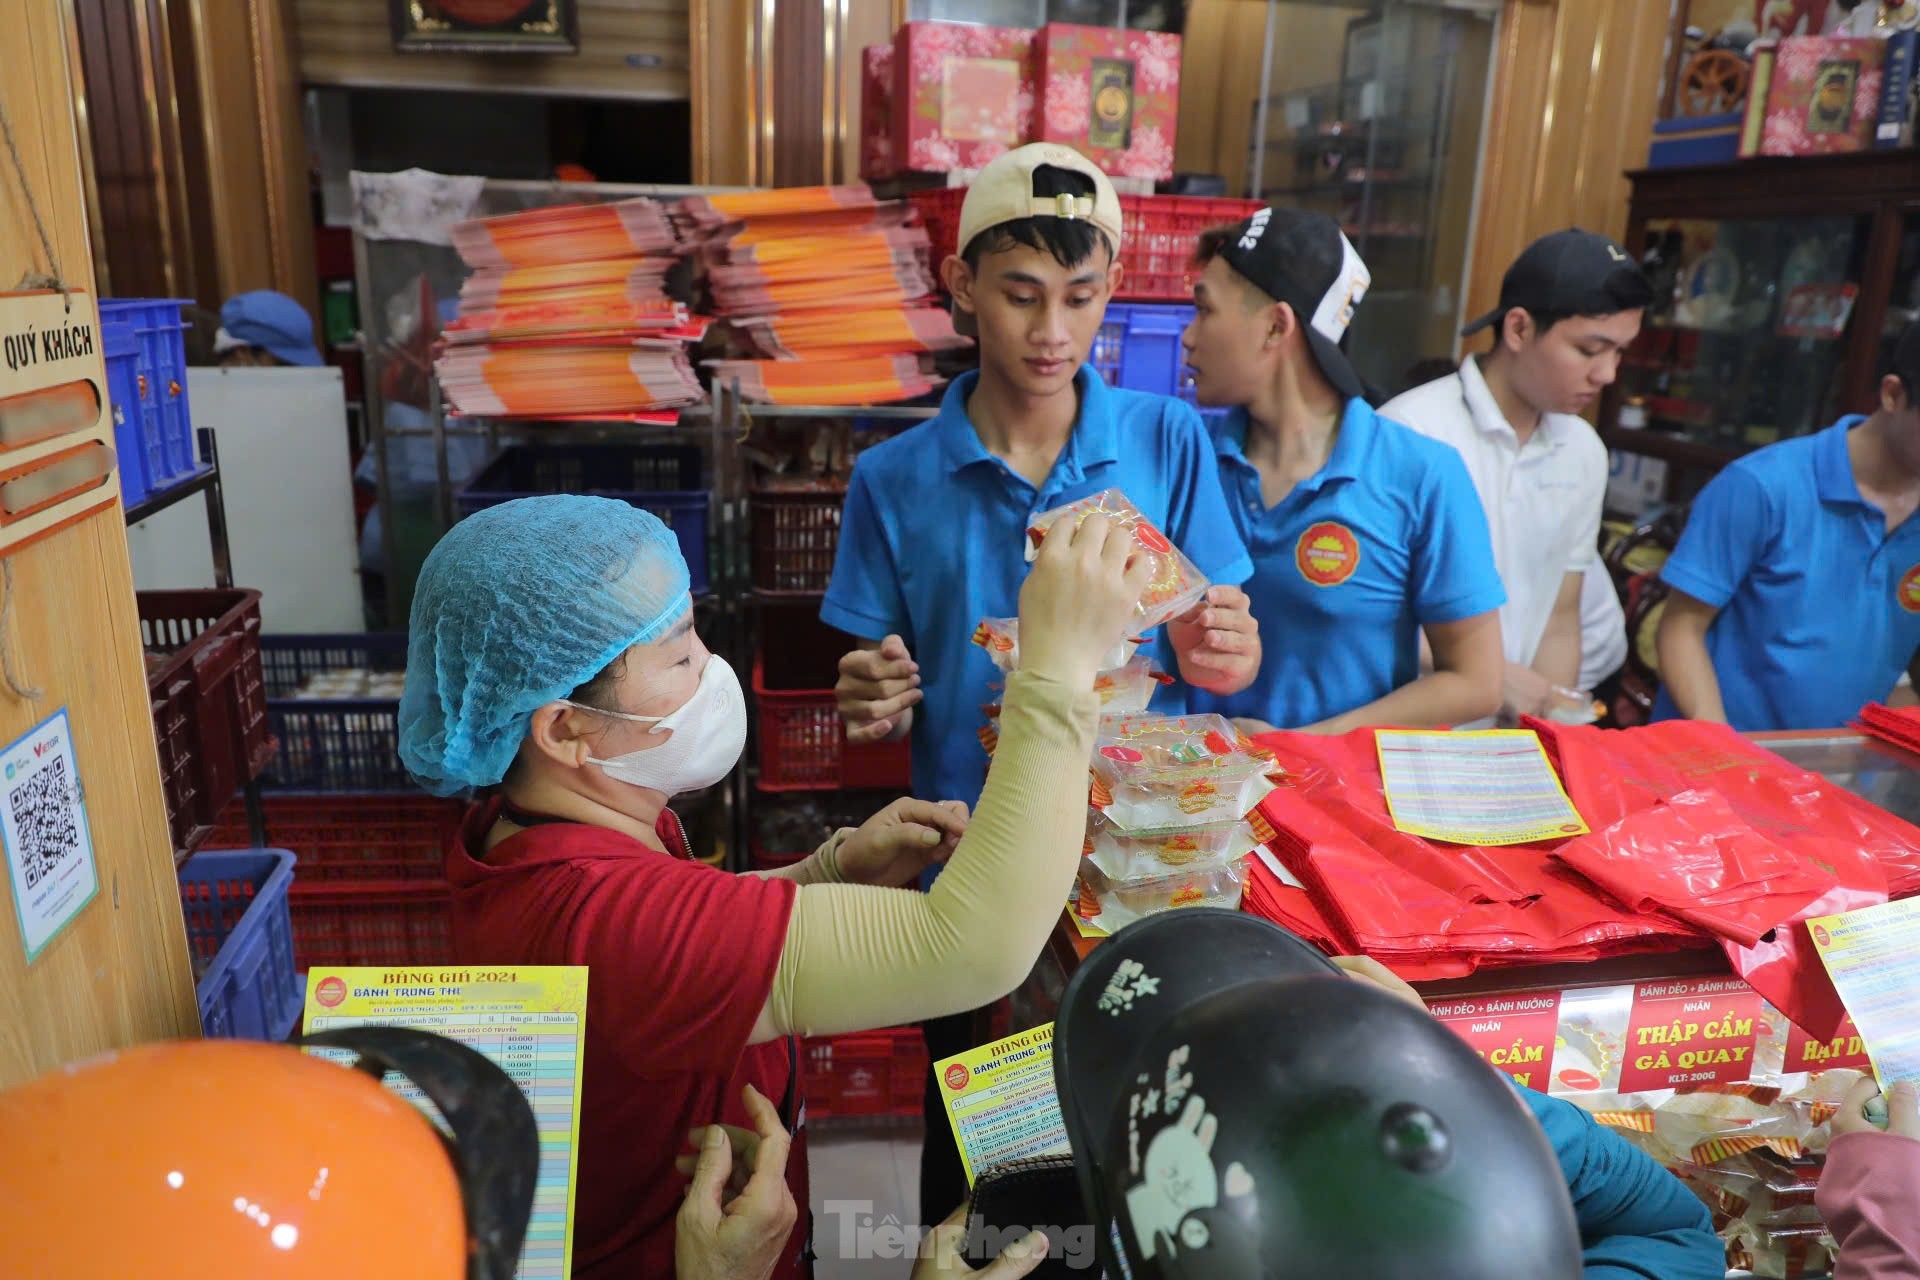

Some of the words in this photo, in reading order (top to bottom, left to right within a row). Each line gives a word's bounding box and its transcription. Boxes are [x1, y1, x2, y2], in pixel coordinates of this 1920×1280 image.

[4, 324, 37, 372] QUÝ
[42, 320, 93, 362] KHÁCH
[383, 970, 434, 984] BẢNG
[475, 972, 518, 983] 2024
[394, 987, 435, 997] TRUNG
[1640, 985, 1666, 997] BÁNH
[1668, 982, 1688, 995] DẺO
[1697, 981, 1723, 992] BÁNH
[1724, 979, 1752, 990] NƯỚN
[1430, 1003, 1452, 1016] ÁNH
[1454, 1002, 1475, 1015] DẺO
[1486, 1000, 1514, 1013] BÁNH
[1683, 1000, 1711, 1012] NHÂN
[1471, 1020, 1501, 1033] NHÂN
[1636, 1019, 1698, 1047] THẬP
[1703, 1010, 1753, 1039] CẨM
[991, 1036, 1031, 1057] BẢNG
[1490, 1038, 1544, 1065] CẨM
[1003, 1048, 1036, 1064] TRUNG
[1635, 1050, 1671, 1070] GÀ
[1677, 1046, 1750, 1069] QUAY
[1668, 1073, 1688, 1083] KLT:
[1691, 1071, 1716, 1081] 200G
